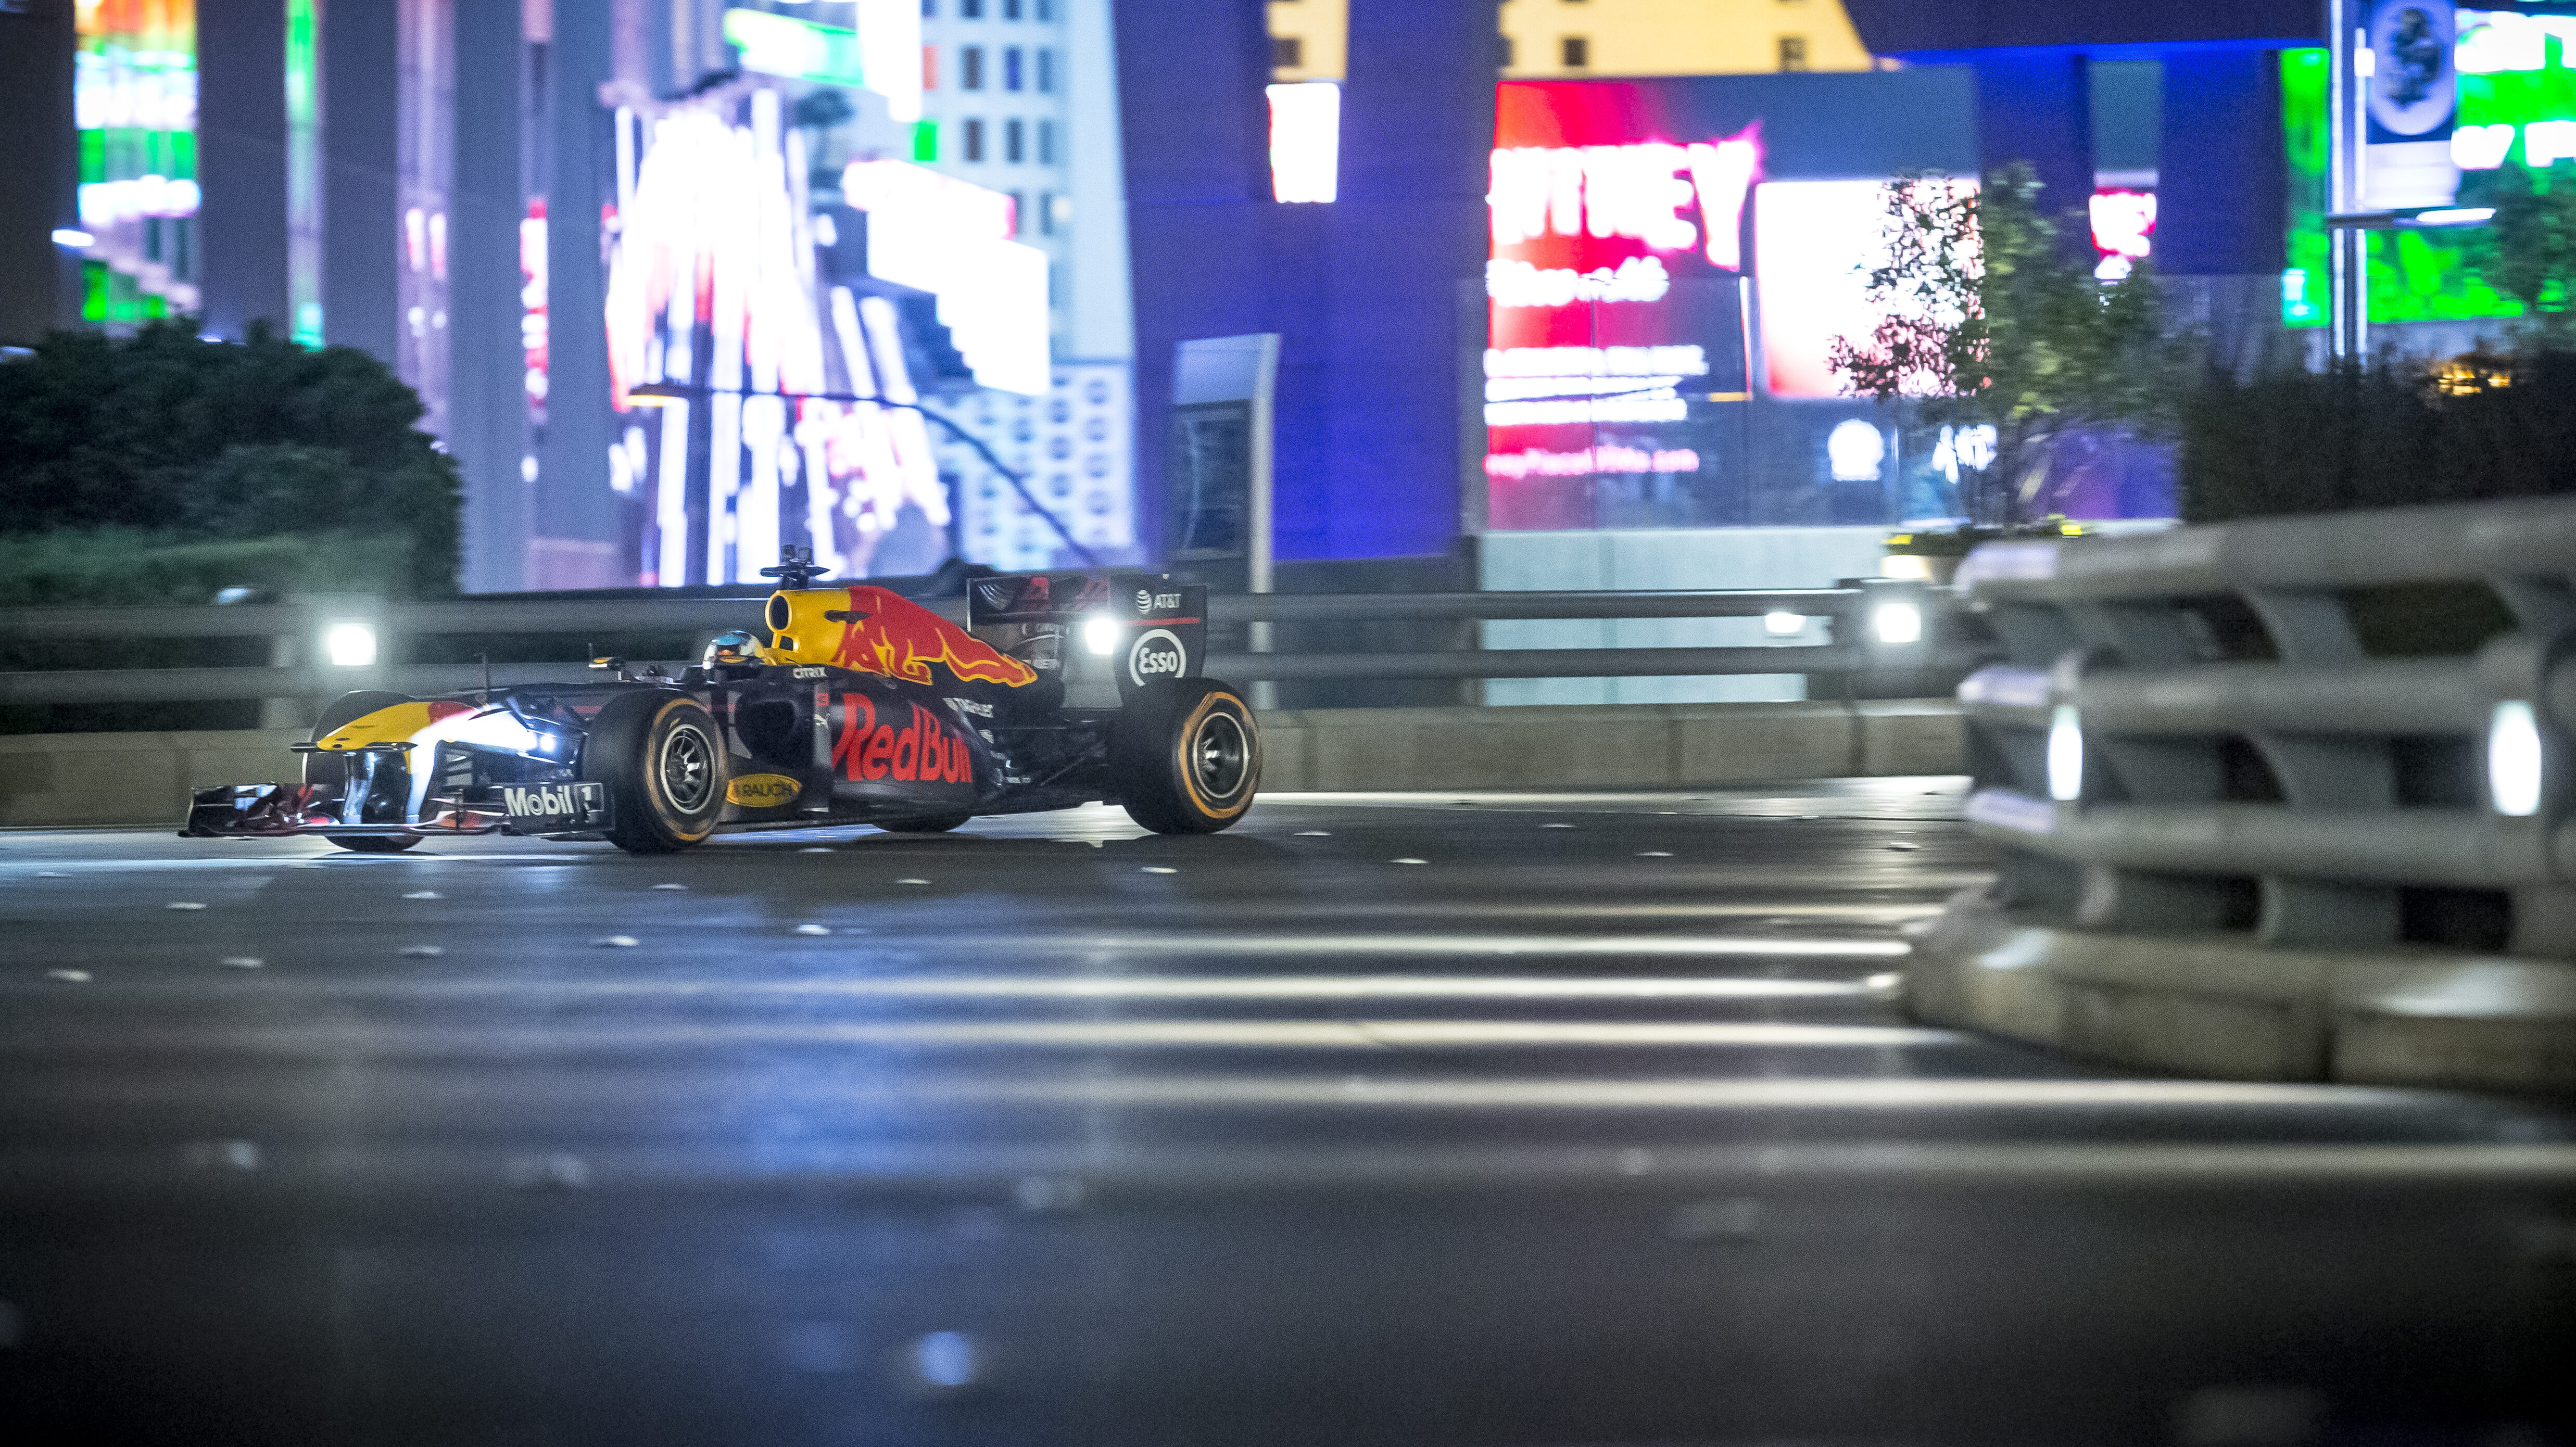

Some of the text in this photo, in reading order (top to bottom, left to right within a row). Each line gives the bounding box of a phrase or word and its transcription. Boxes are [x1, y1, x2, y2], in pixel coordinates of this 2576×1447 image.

[1153, 593, 1181, 609] AT&T
[1139, 647, 1178, 674] Esso
[815, 693, 829, 706] 3
[742, 783, 793, 797] RAUCH
[504, 785, 575, 816] Mobil
